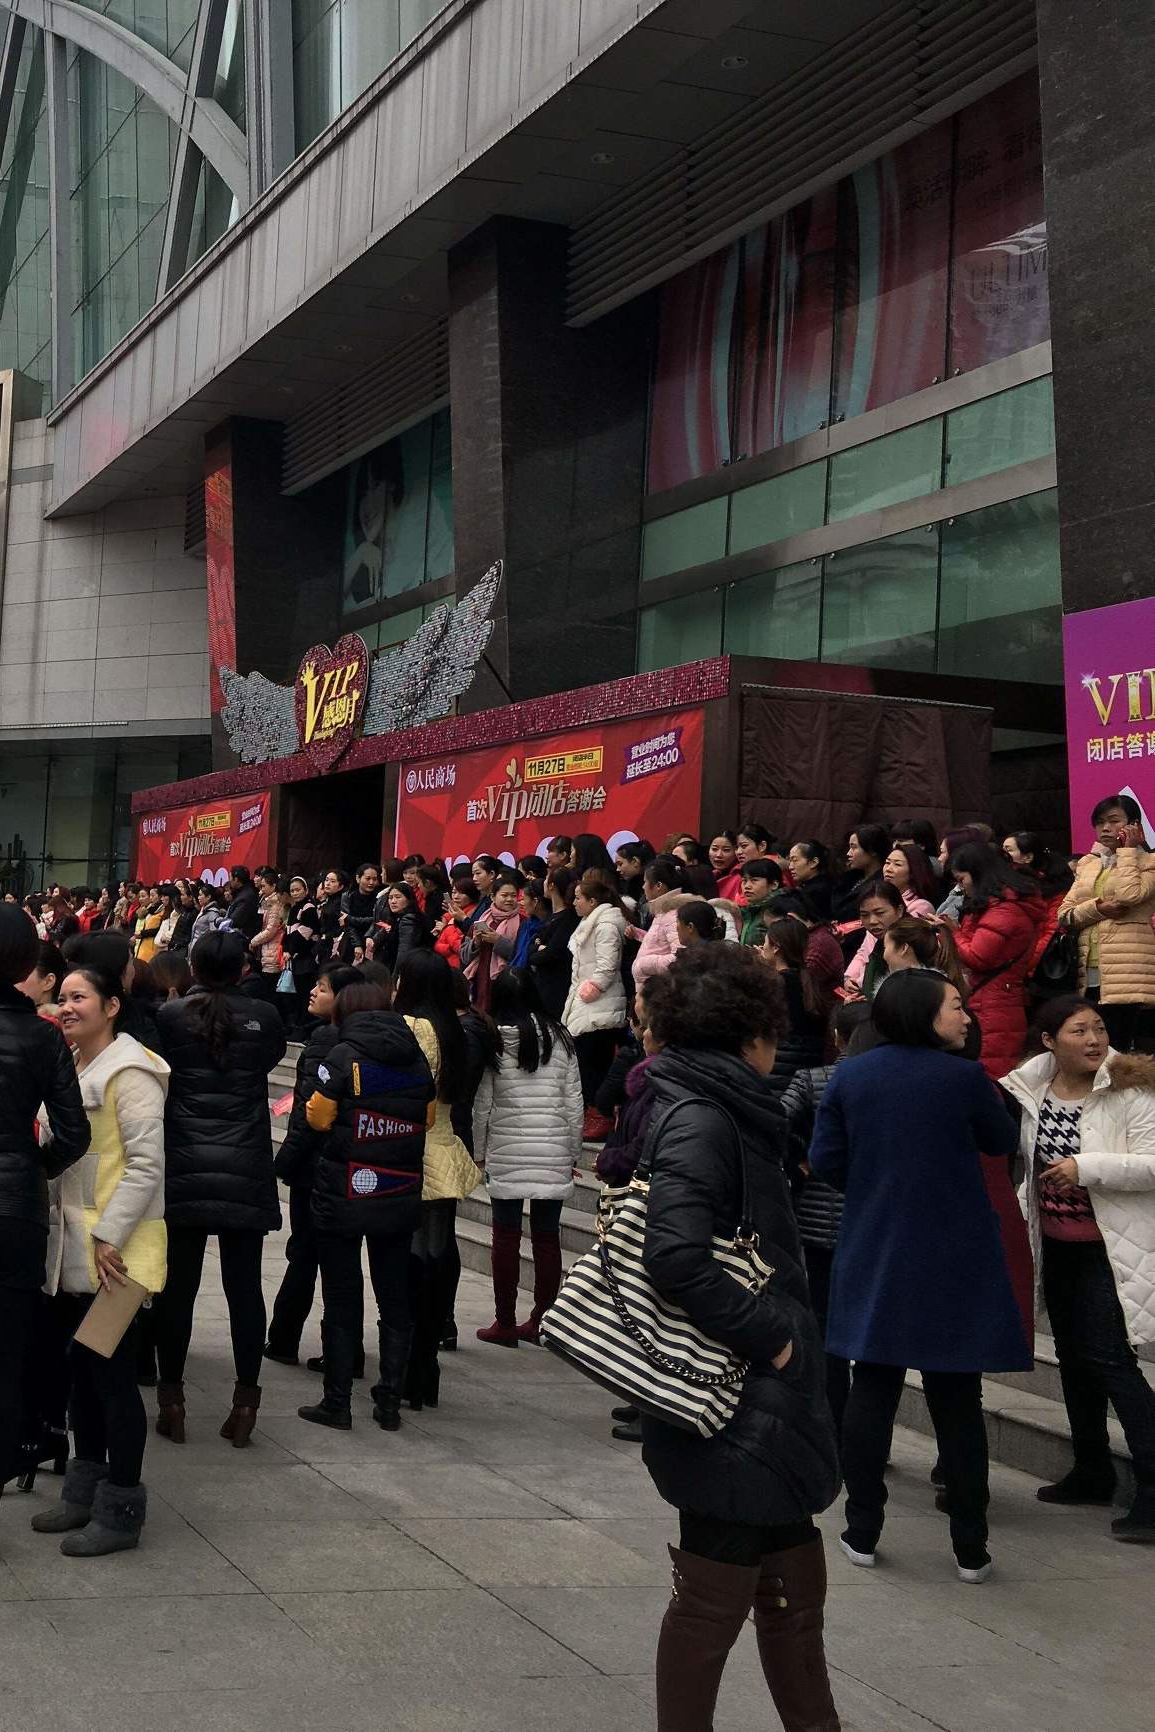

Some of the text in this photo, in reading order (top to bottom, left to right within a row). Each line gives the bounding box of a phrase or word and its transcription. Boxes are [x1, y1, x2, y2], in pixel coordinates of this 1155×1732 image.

[415, 764, 456, 790] 人民商场
[357, 1113, 414, 1139] FASHION
